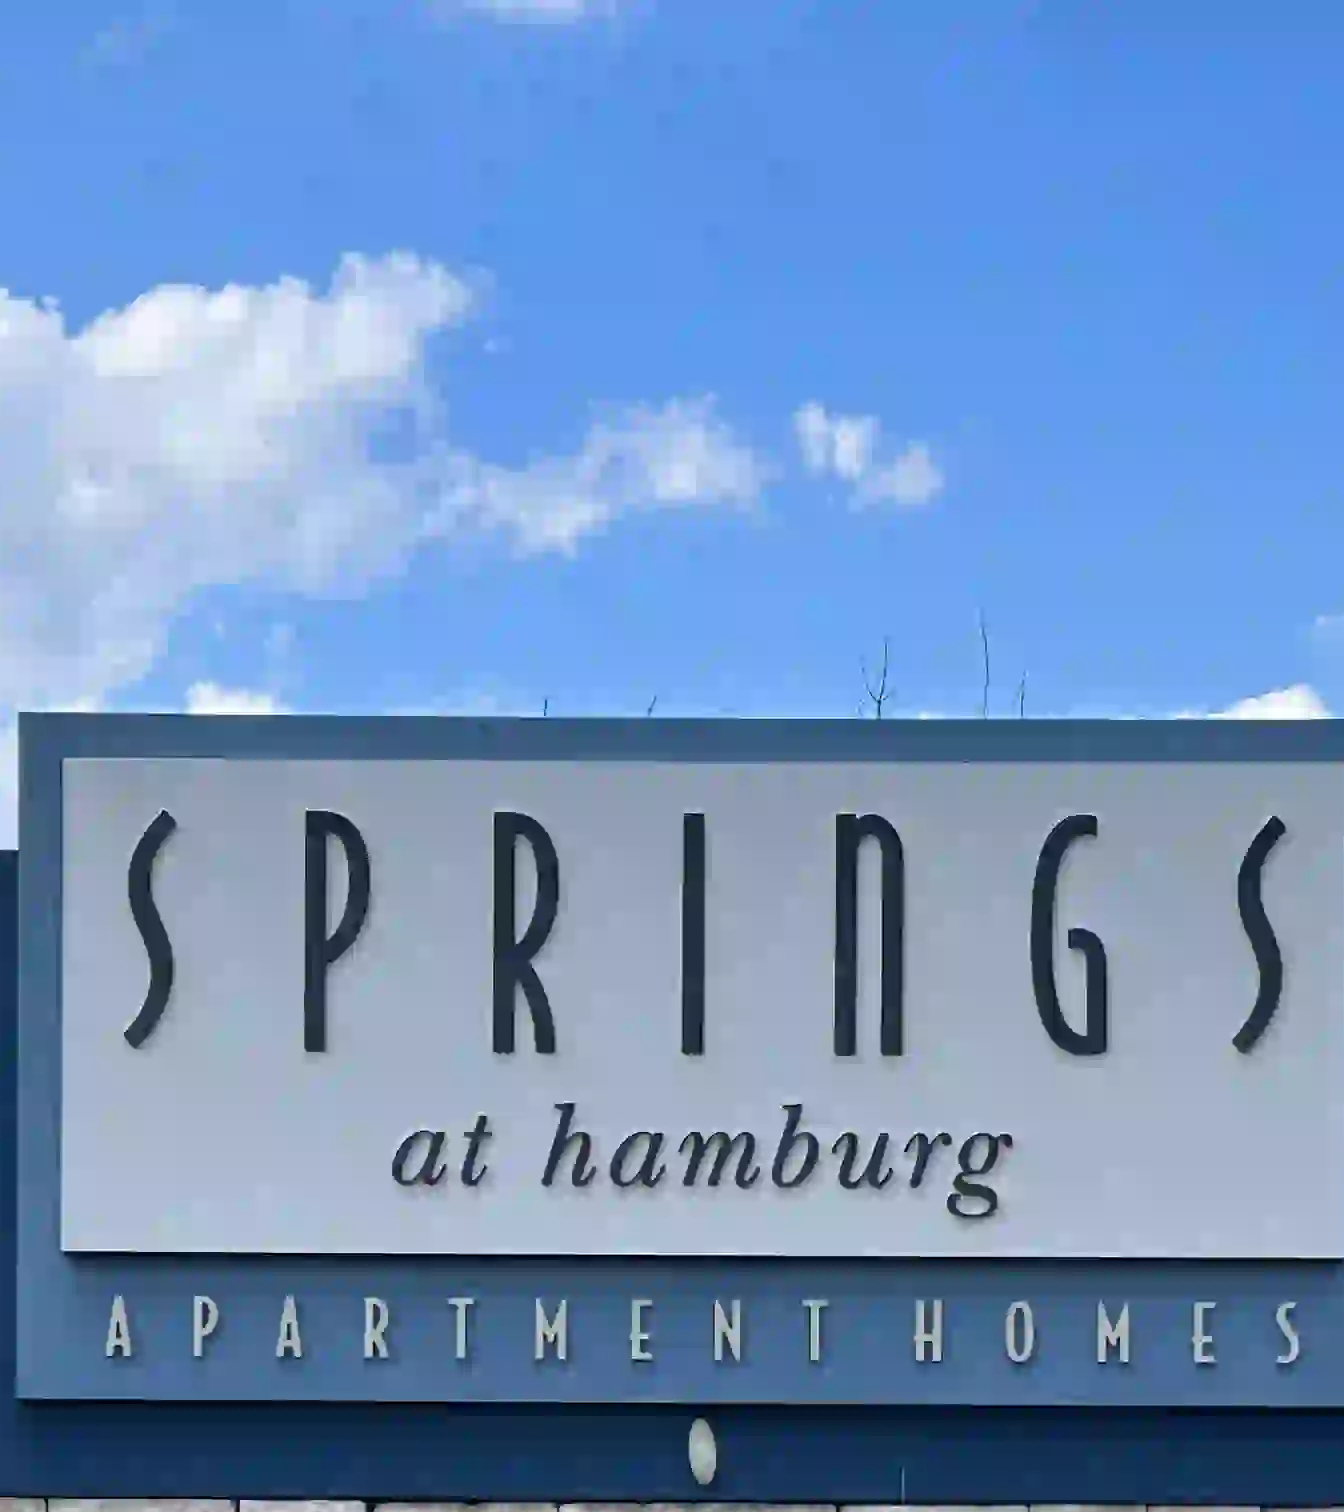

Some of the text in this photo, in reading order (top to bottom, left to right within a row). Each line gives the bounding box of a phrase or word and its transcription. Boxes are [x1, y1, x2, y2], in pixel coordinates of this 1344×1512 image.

[123, 809, 1288, 1057] SPRINGS
[391, 1102, 1014, 1221] at hamburg
[105, 1294, 1302, 1365] APARTMENT HOMES
